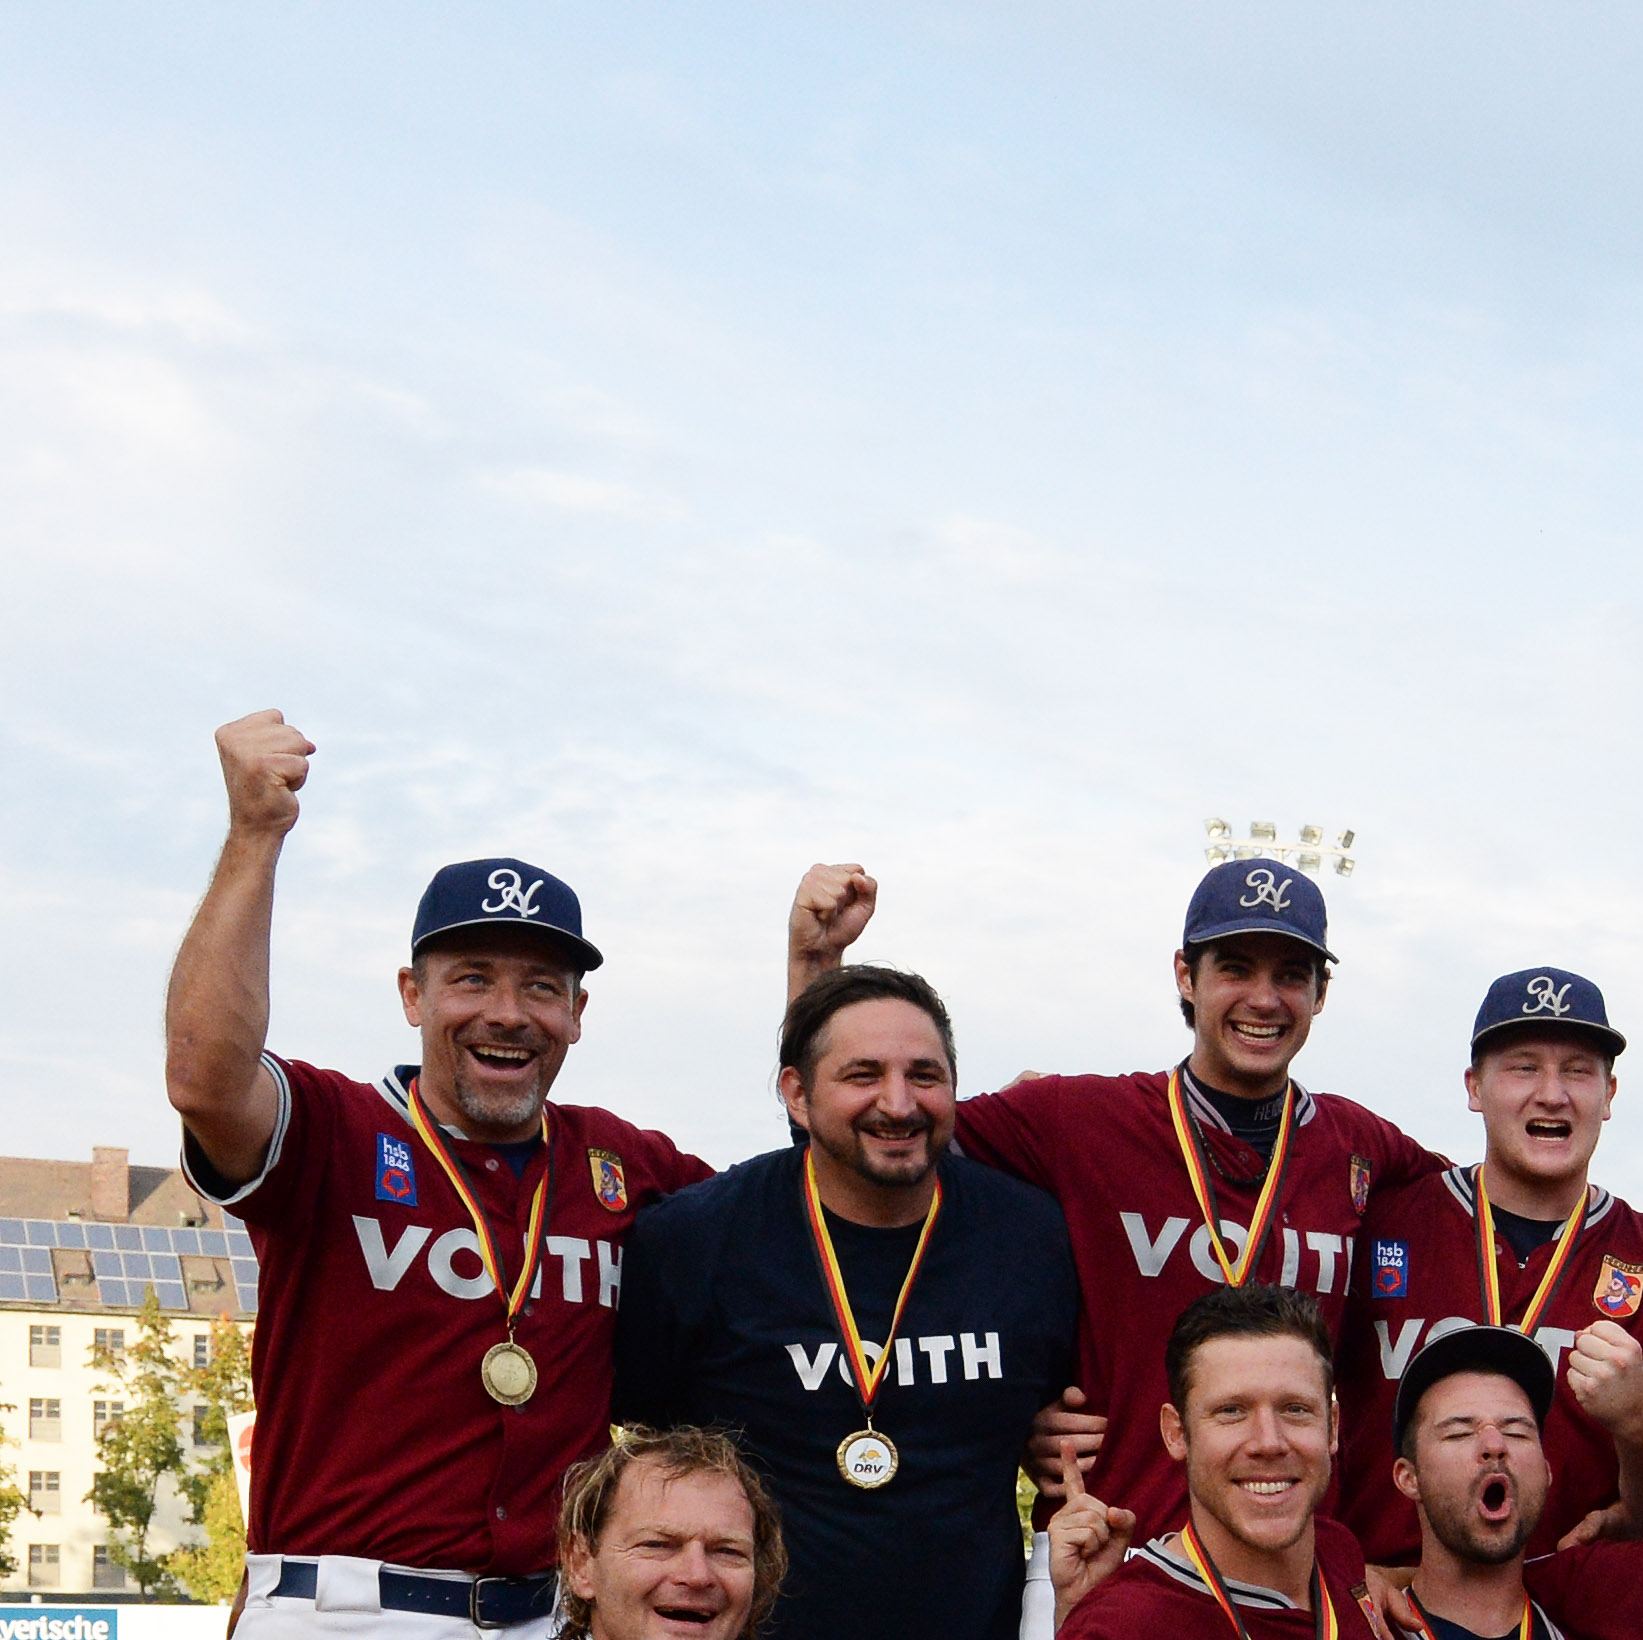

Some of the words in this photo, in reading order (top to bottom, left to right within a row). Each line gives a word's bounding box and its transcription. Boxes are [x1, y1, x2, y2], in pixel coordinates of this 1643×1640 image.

[383, 1153, 410, 1171] 1846
[1377, 1241, 1403, 1258] hsb
[1376, 1257, 1403, 1269] 1846
[854, 1462, 884, 1475] DBV
